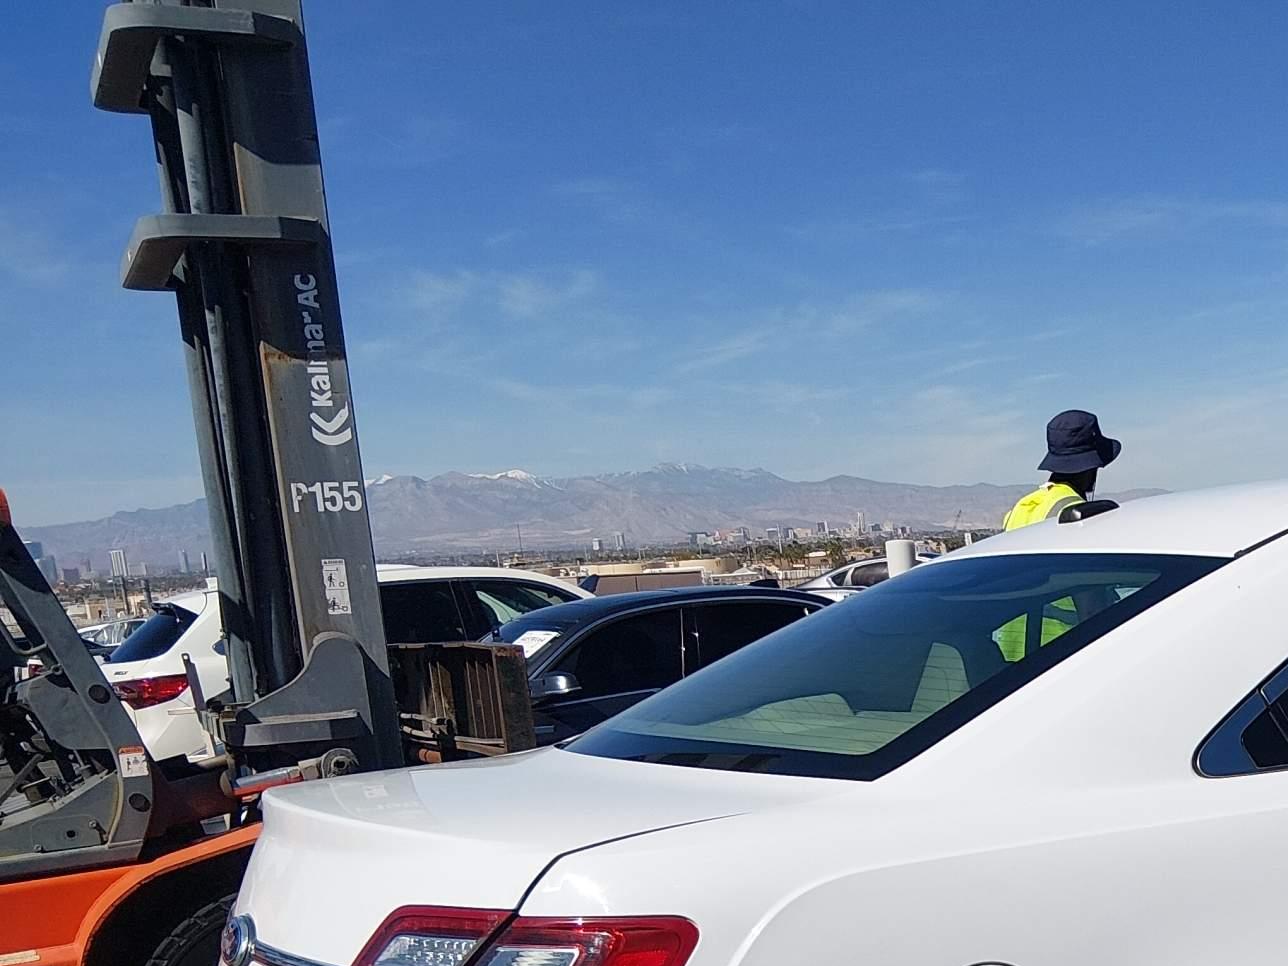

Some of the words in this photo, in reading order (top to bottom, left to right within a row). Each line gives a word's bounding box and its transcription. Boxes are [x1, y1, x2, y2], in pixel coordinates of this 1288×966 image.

[293, 273, 320, 310] AC
[301, 311, 334, 408] Kalmar
[290, 480, 363, 514] P155
